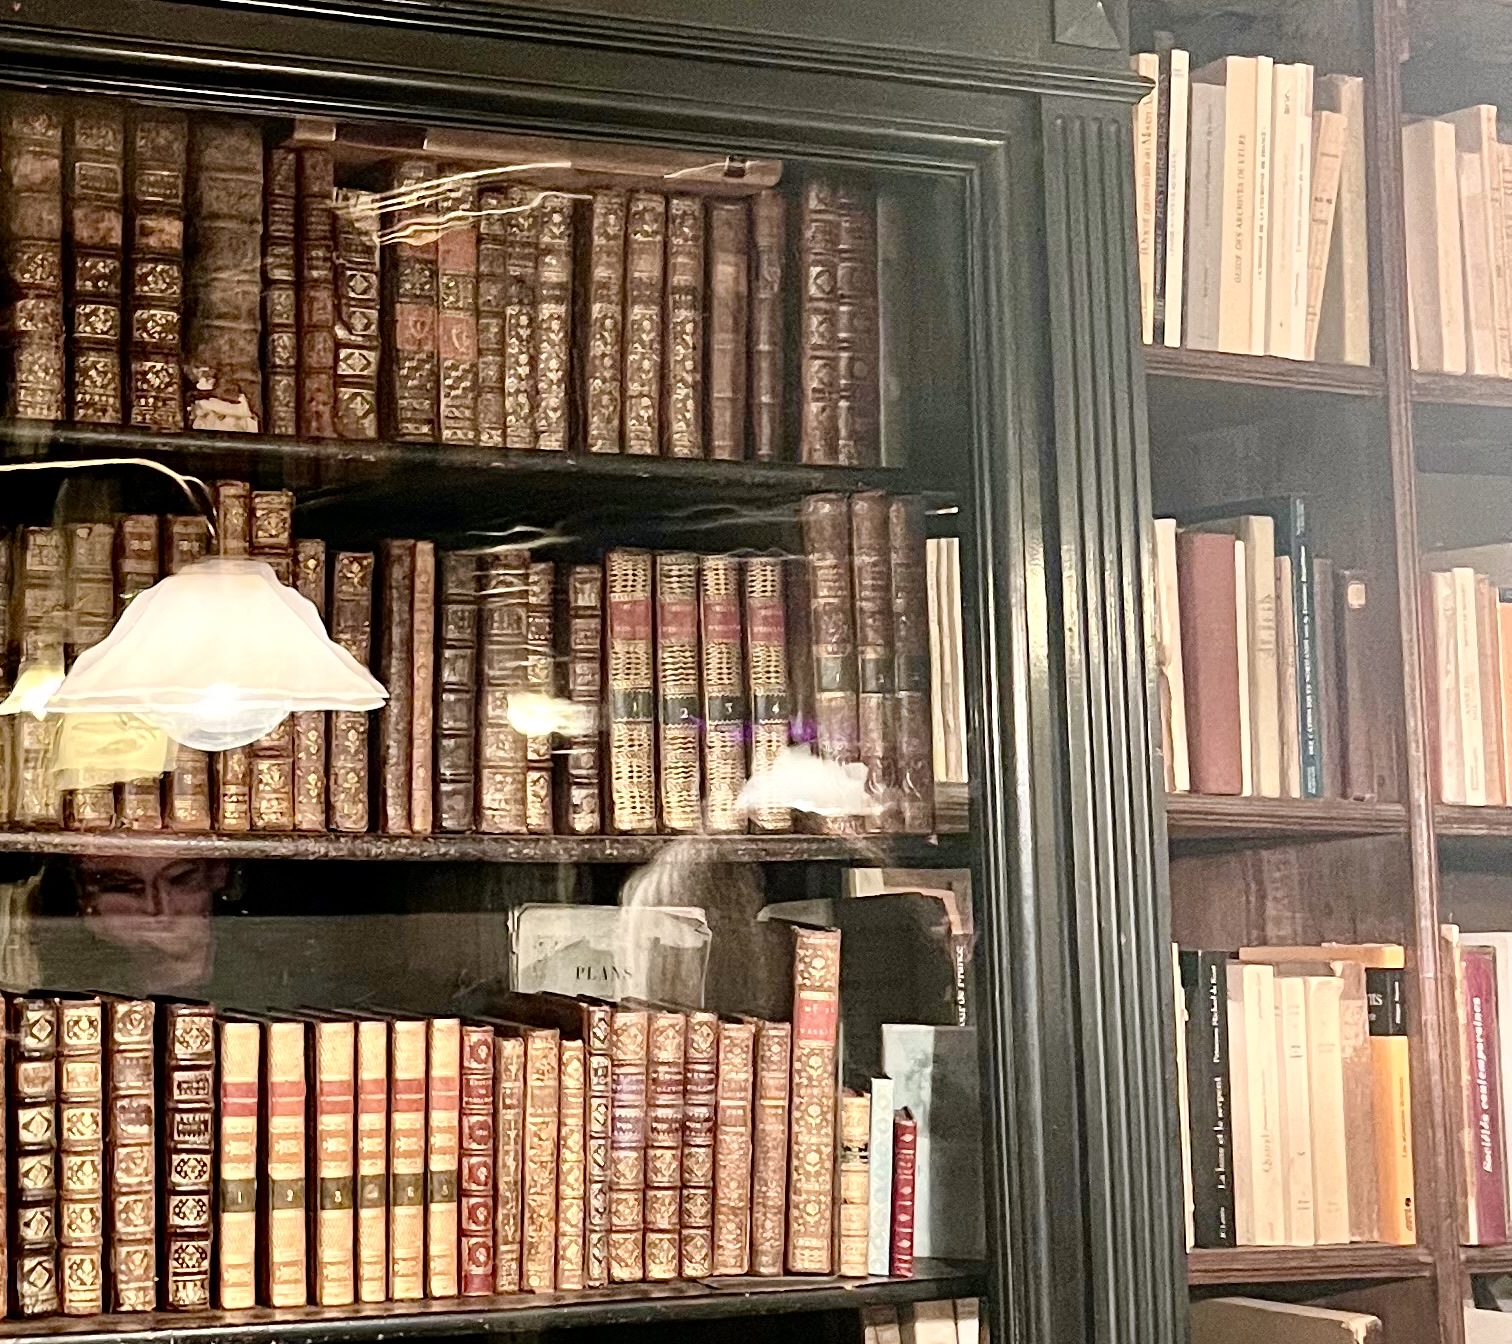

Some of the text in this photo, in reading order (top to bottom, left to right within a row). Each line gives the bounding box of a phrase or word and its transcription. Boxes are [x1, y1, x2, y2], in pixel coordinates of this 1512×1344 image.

[1233, 165, 1246, 284] GUIDE DES ARCHIVES DE
[574, 965, 633, 983] PLANS
[1472, 997, 1489, 1110] contemporaines
[1214, 1076, 1227, 1190] La et serpent
